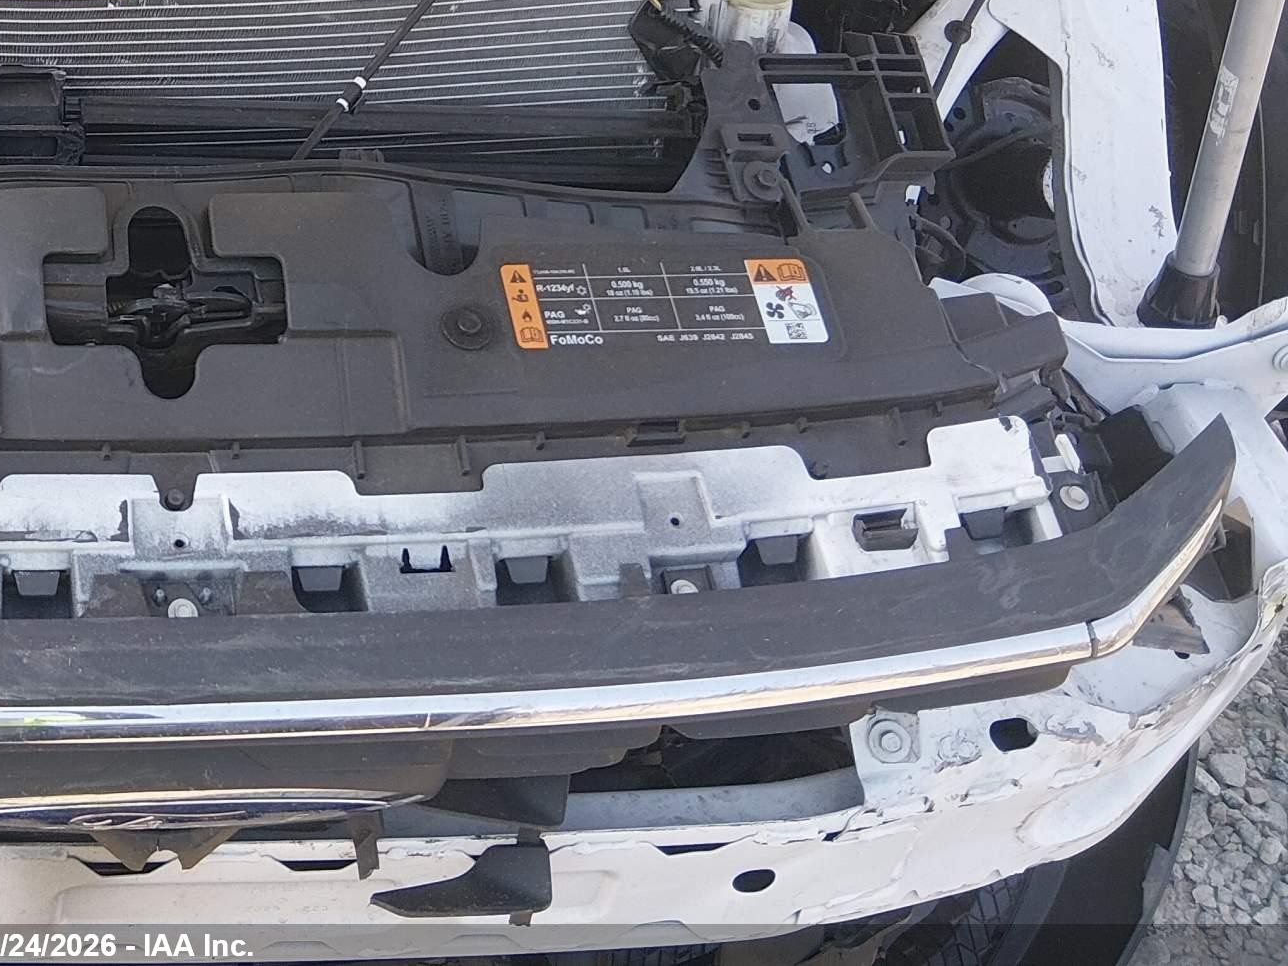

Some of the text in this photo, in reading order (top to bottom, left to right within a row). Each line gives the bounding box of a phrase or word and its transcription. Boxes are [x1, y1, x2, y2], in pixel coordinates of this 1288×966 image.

[610, 280, 644, 290] 0.500 kg
[692, 278, 726, 287] 0.550 kg
[535, 283, 575, 294] R-1234yf
[544, 310, 566, 319] PAG
[626, 306, 643, 314] PAG
[549, 334, 604, 345] FoMoCo
[656, 334, 675, 342] SAE
